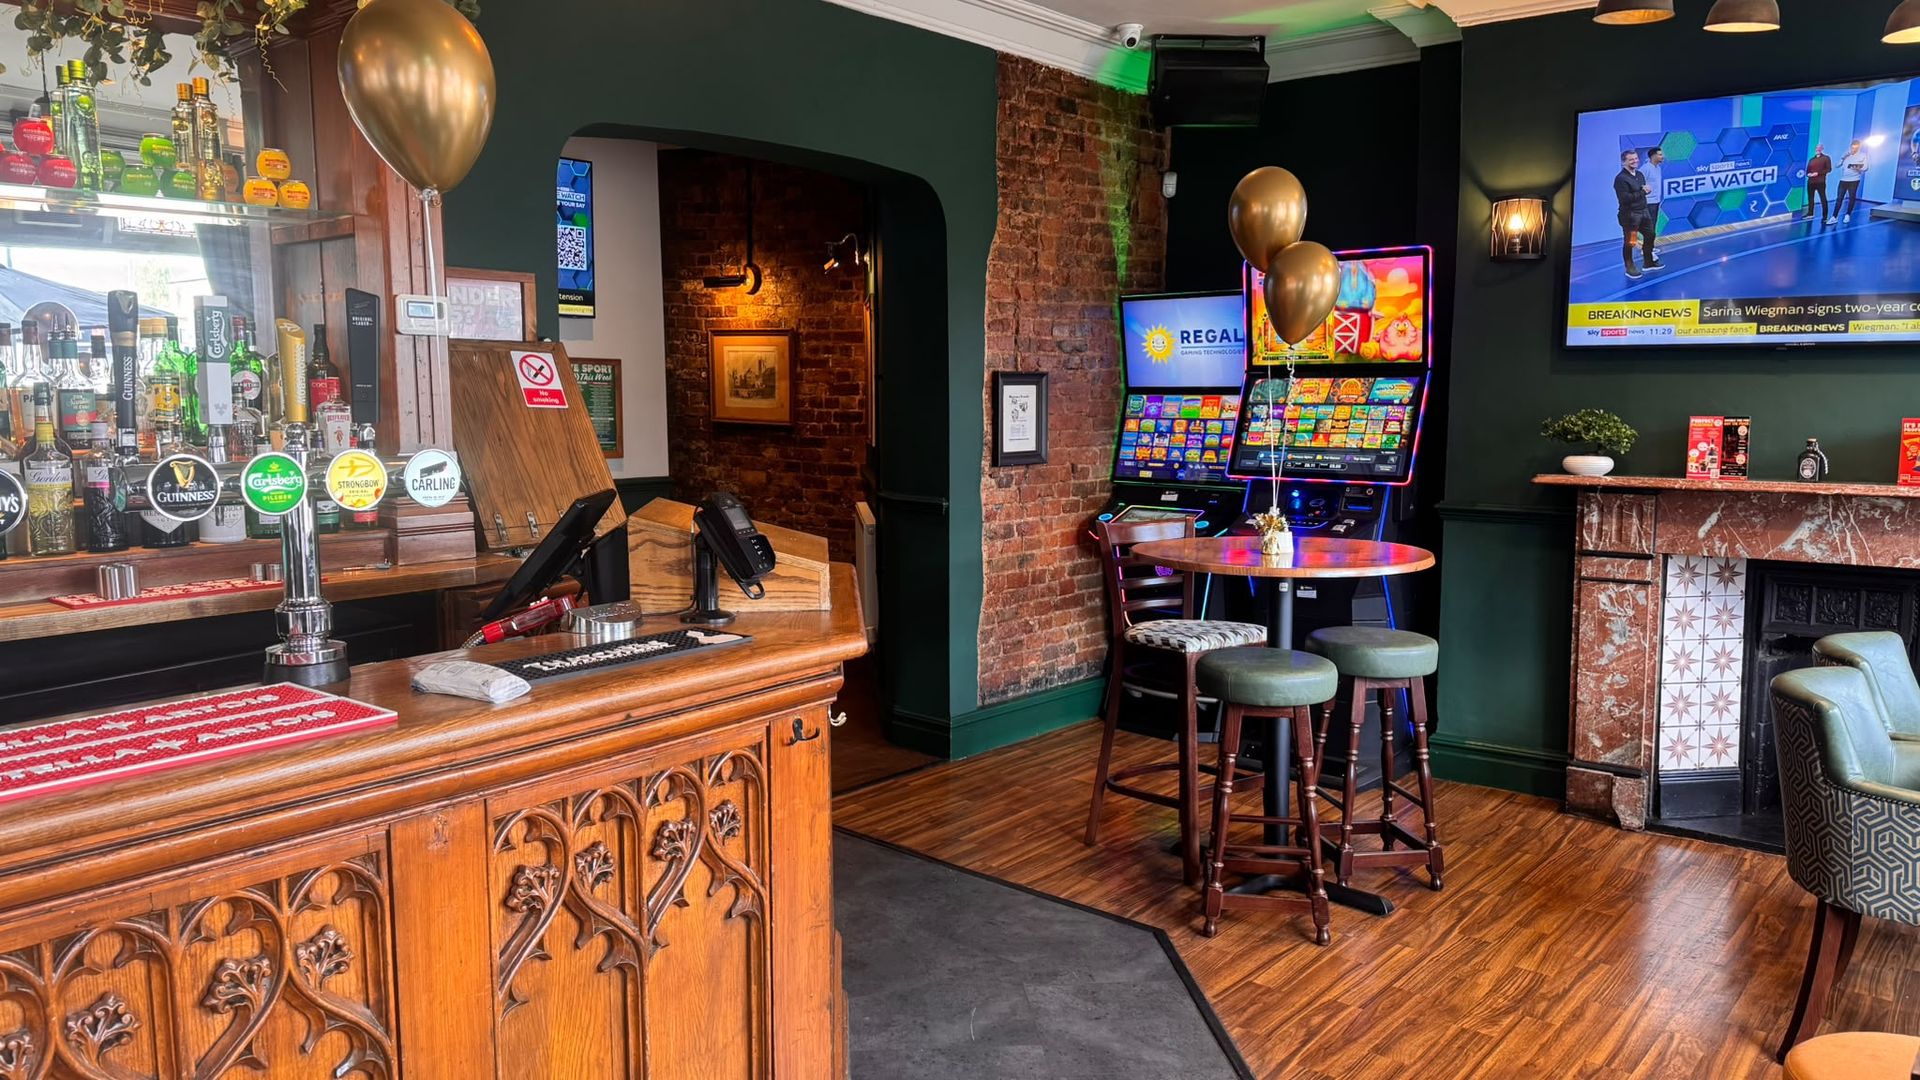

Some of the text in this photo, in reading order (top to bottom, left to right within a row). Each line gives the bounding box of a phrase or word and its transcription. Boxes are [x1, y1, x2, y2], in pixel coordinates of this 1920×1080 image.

[1667, 168, 1775, 195] REF WATCH
[1588, 308, 1692, 320] BREAKING NEWS
[1703, 306, 1742, 317] Sarina
[1745, 304, 1804, 318] Wiegman
[1807, 303, 1842, 318] signs
[1845, 302, 1909, 315] two-year
[207, 310, 228, 359] Carlsberg
[1693, 327, 1728, 335] amazing
[1759, 323, 1845, 333] BREAKING NEWS
[1853, 323, 1900, 333] Wiegman:
[1180, 328, 1245, 344] REGAL
[582, 364, 612, 374] SPORT
[122, 355, 133, 401] GUINNESS
[247, 470, 303, 493] Carlsberg
[338, 479, 379, 489] STRONGBOW
[412, 477, 456, 491] CARLING
[157, 490, 215, 503] GUINNESS
